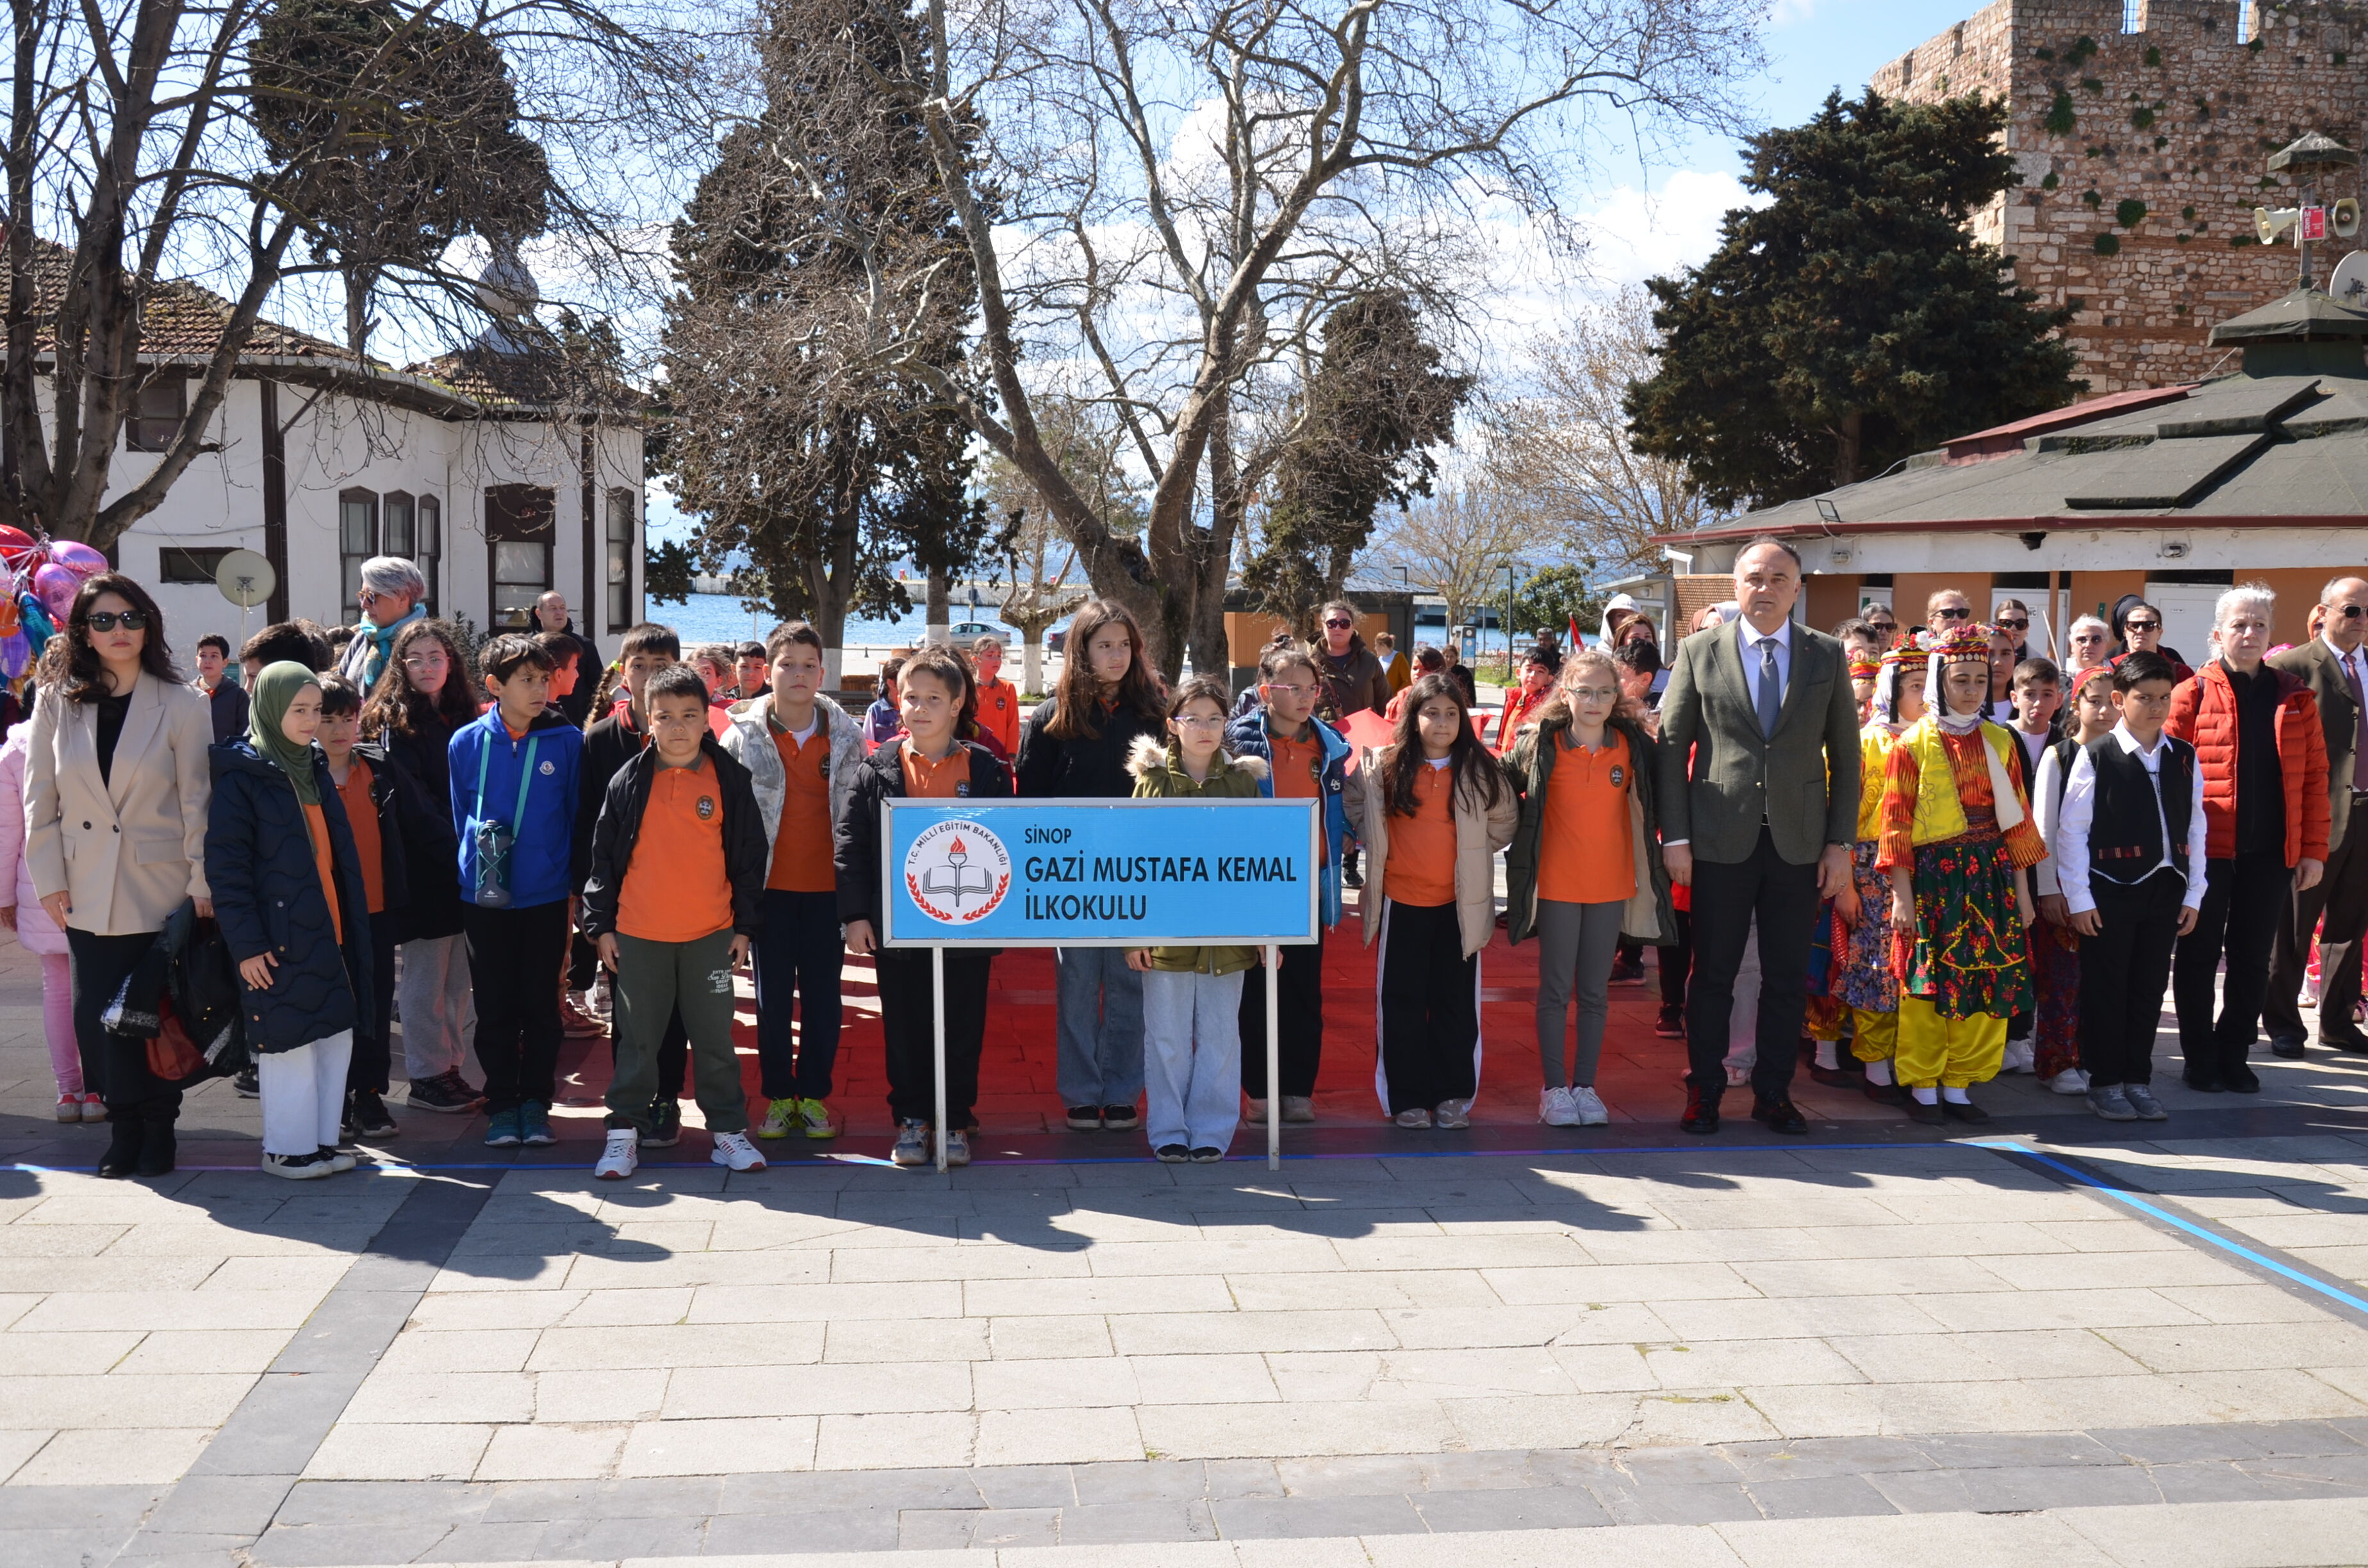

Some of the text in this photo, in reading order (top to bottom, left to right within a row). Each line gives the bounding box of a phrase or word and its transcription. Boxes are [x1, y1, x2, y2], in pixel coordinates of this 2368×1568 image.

[908, 821, 1008, 865] T.C. MİLLİ EĞİTİM BAKANLIĞI
[1024, 824, 1072, 844] SİNOP
[1025, 849, 1297, 883] GAZİ MUSTAFA KEMAL
[1025, 888, 1146, 920] İLKOKULU
